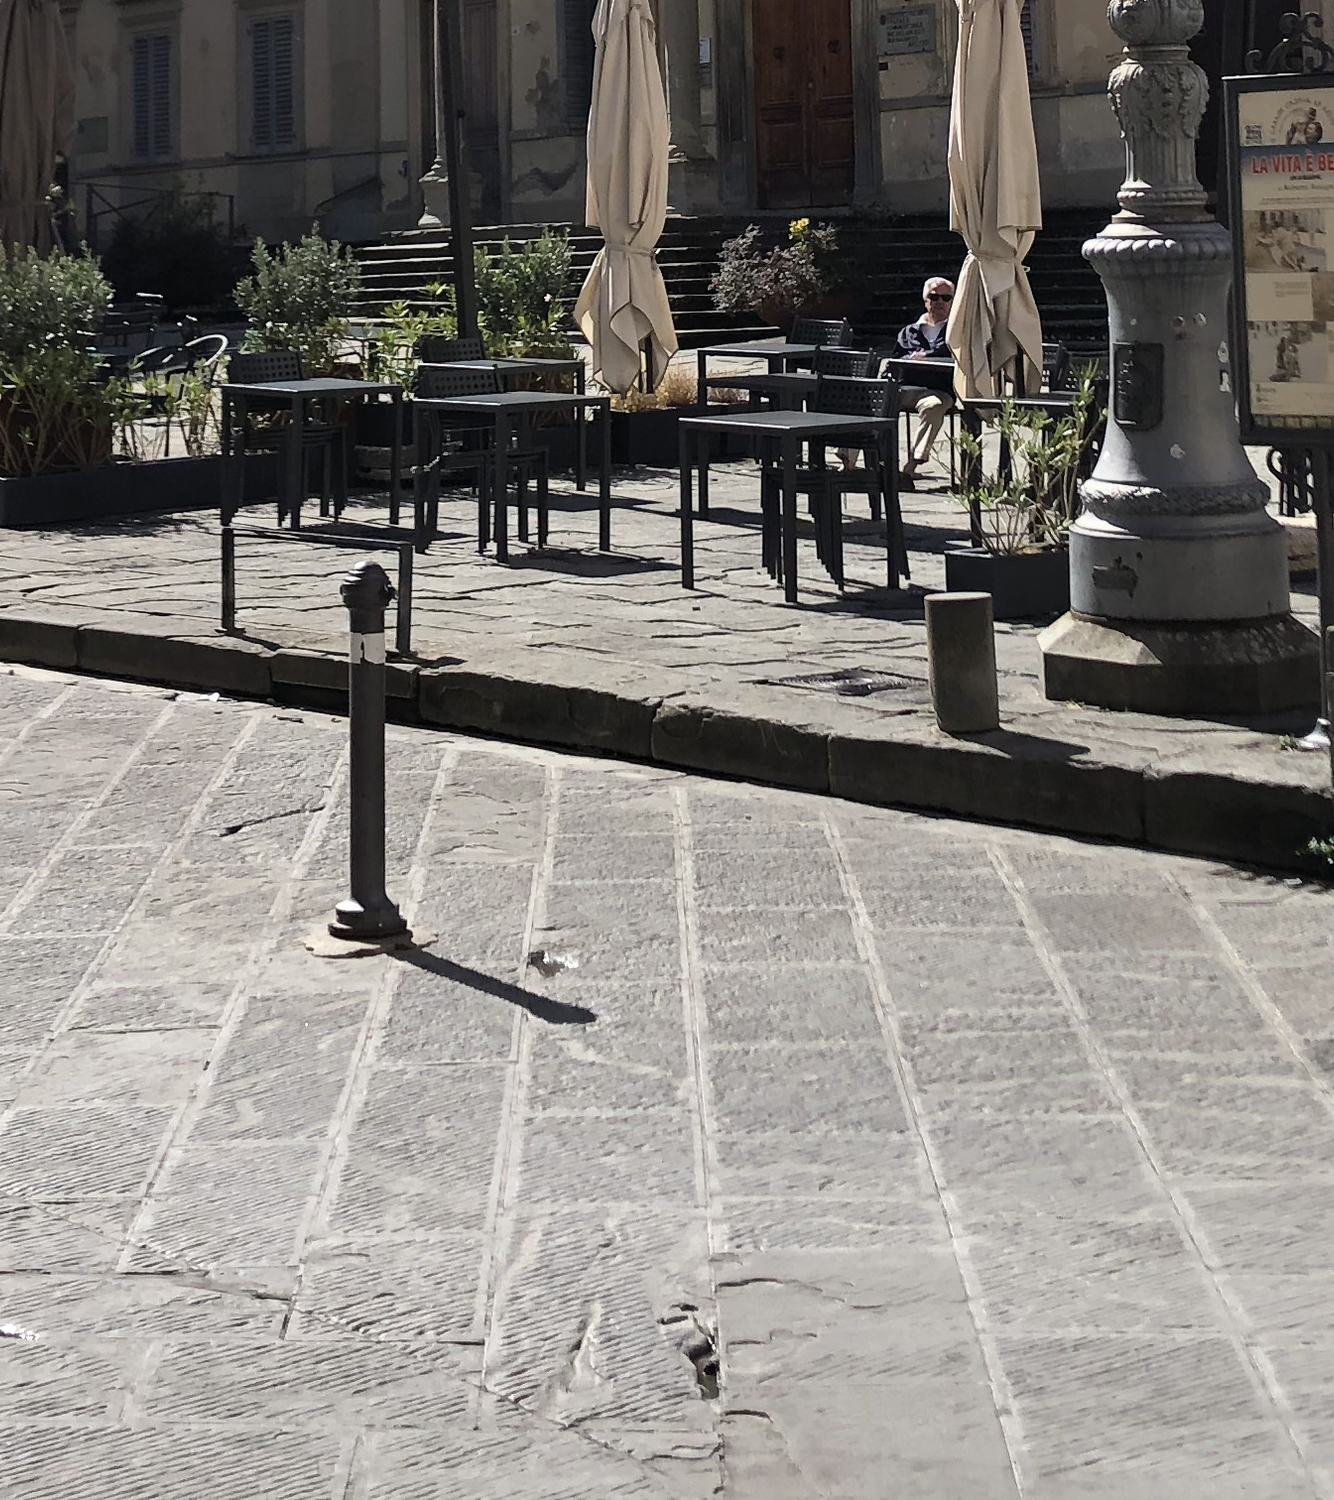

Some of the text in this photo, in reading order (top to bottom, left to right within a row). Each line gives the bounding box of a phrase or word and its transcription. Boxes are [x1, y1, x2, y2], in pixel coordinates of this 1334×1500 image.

[1252, 155, 1269, 175] LA
[1271, 154, 1302, 173] VITA
[1305, 150, 1314, 172] È
